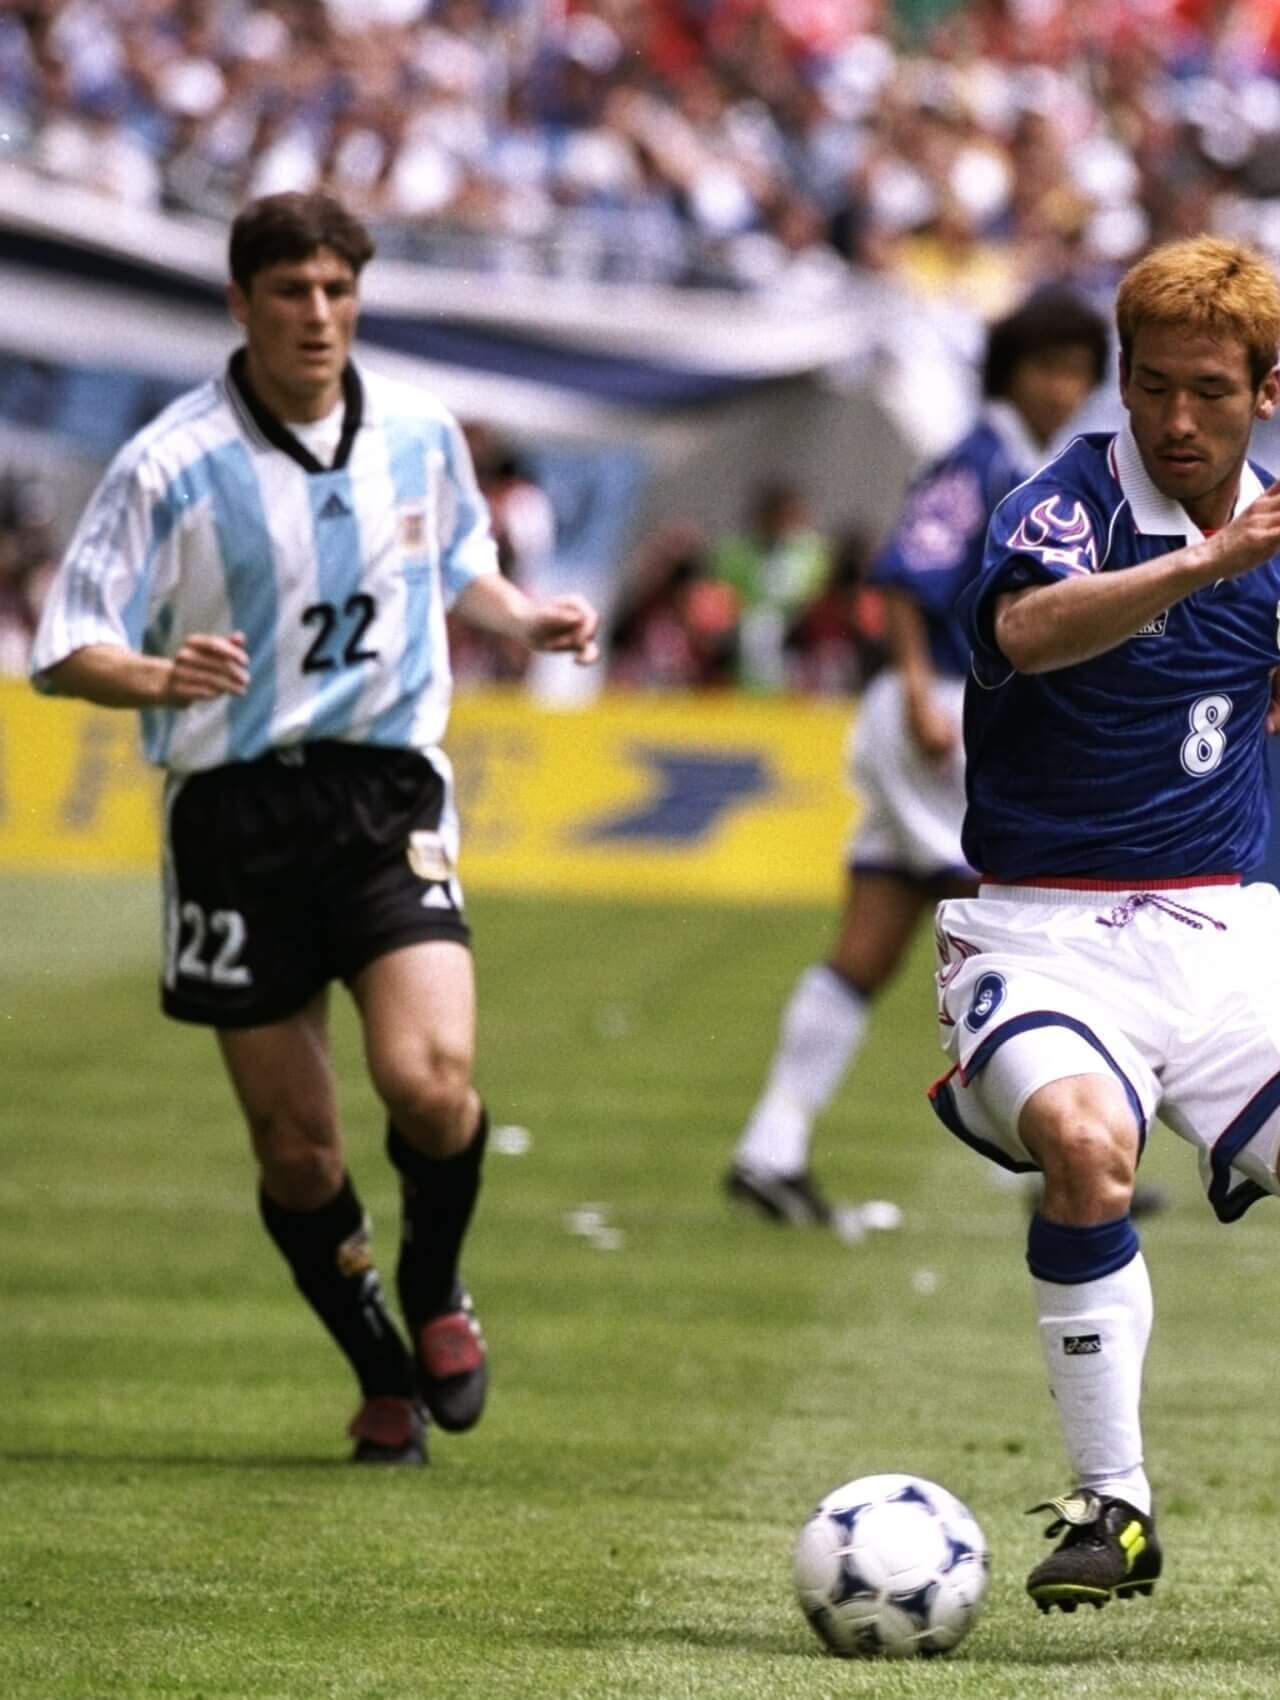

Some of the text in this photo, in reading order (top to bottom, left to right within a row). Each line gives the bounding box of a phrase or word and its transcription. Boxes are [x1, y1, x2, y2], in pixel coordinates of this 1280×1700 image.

[301, 592, 380, 675] 22
[1180, 693, 1233, 777] 8
[179, 900, 255, 986] 22
